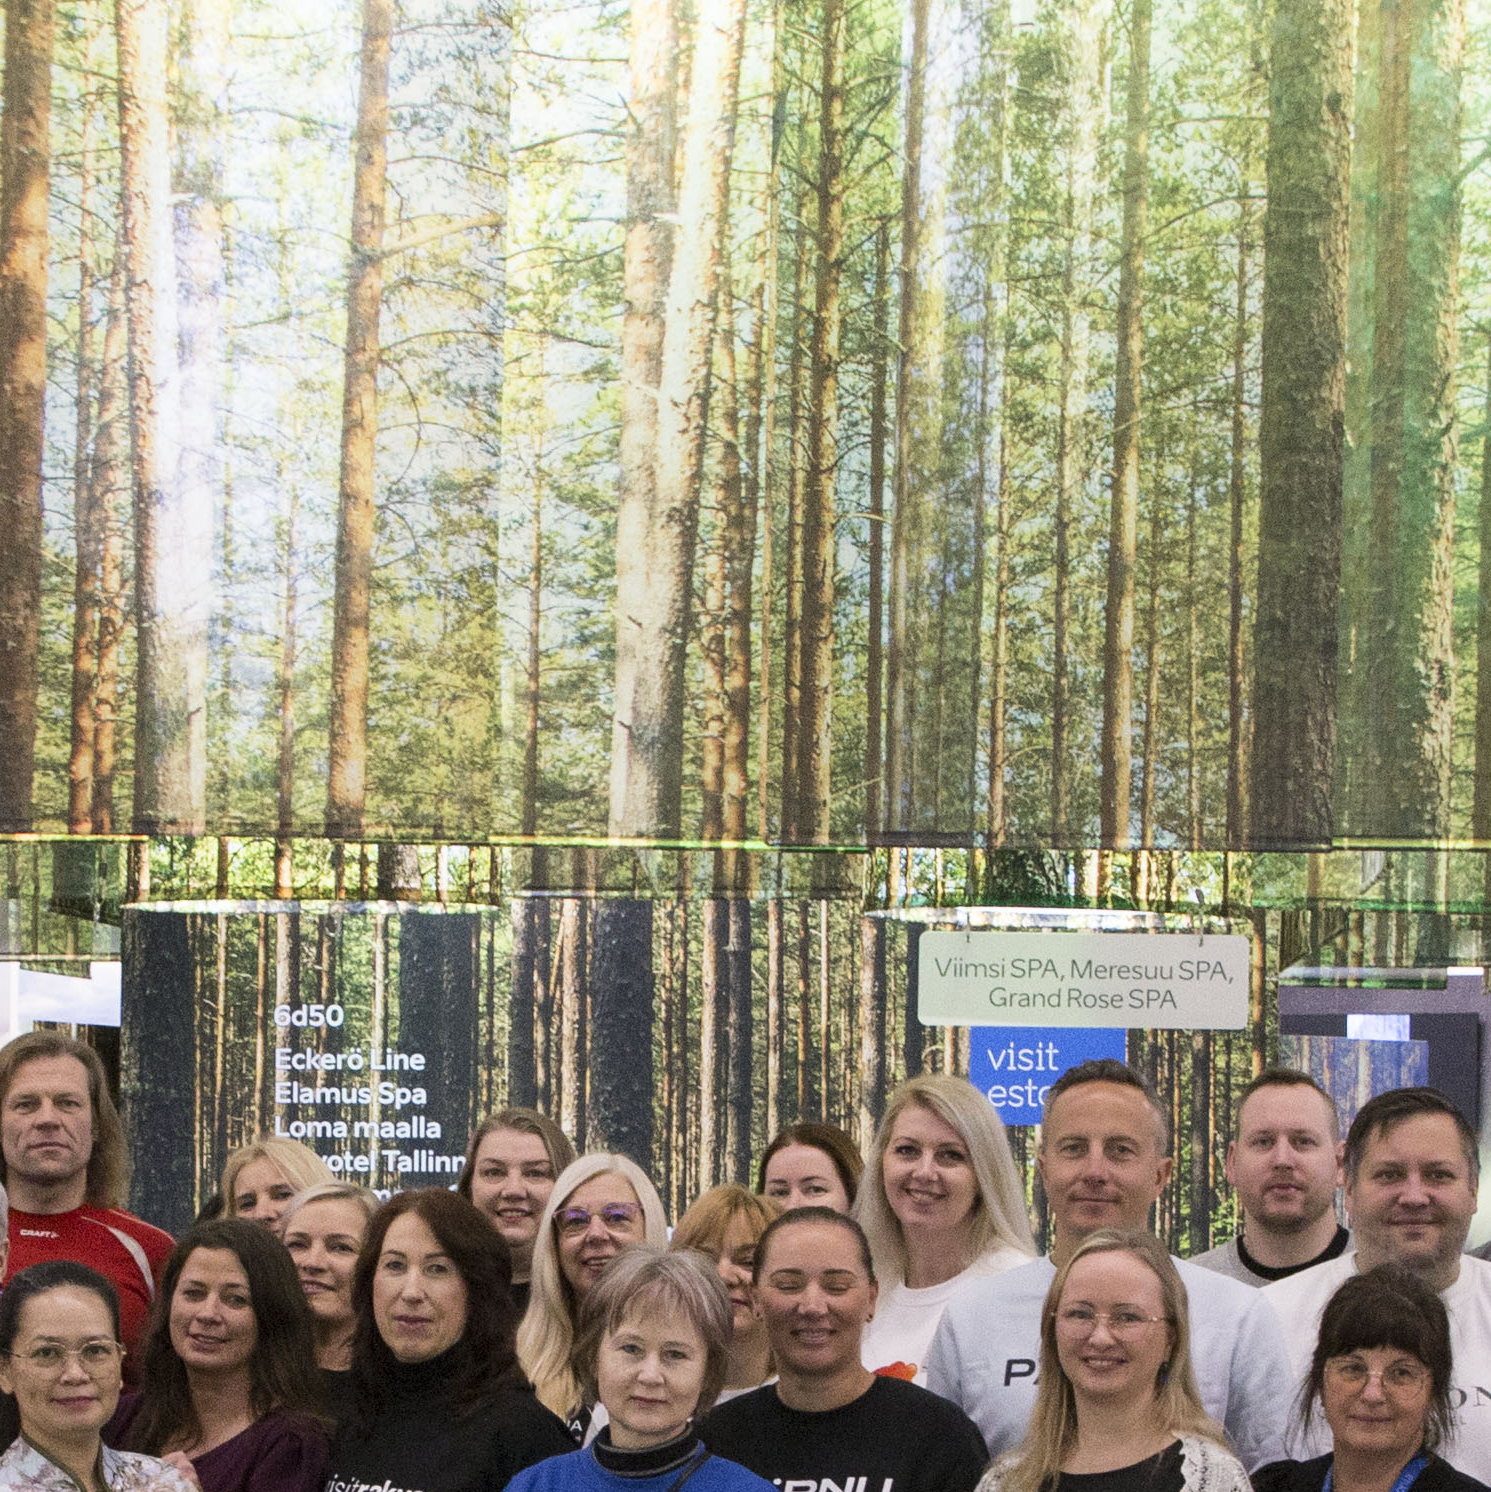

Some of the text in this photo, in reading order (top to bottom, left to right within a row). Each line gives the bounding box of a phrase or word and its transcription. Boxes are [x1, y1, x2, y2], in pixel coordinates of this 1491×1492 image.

[934, 957, 1234, 985] Viimsi SPA, Meresuu SPA,
[988, 986, 1177, 1010] Grand Rose SPA
[274, 1003, 344, 1027] 6d50
[274, 1047, 426, 1071] Eckerö Line
[987, 1041, 1059, 1071] visit
[274, 1081, 427, 1110] Elamus Spa
[274, 1115, 441, 1139] Loma maalla
[321, 1149, 467, 1172] votel Tallinn
